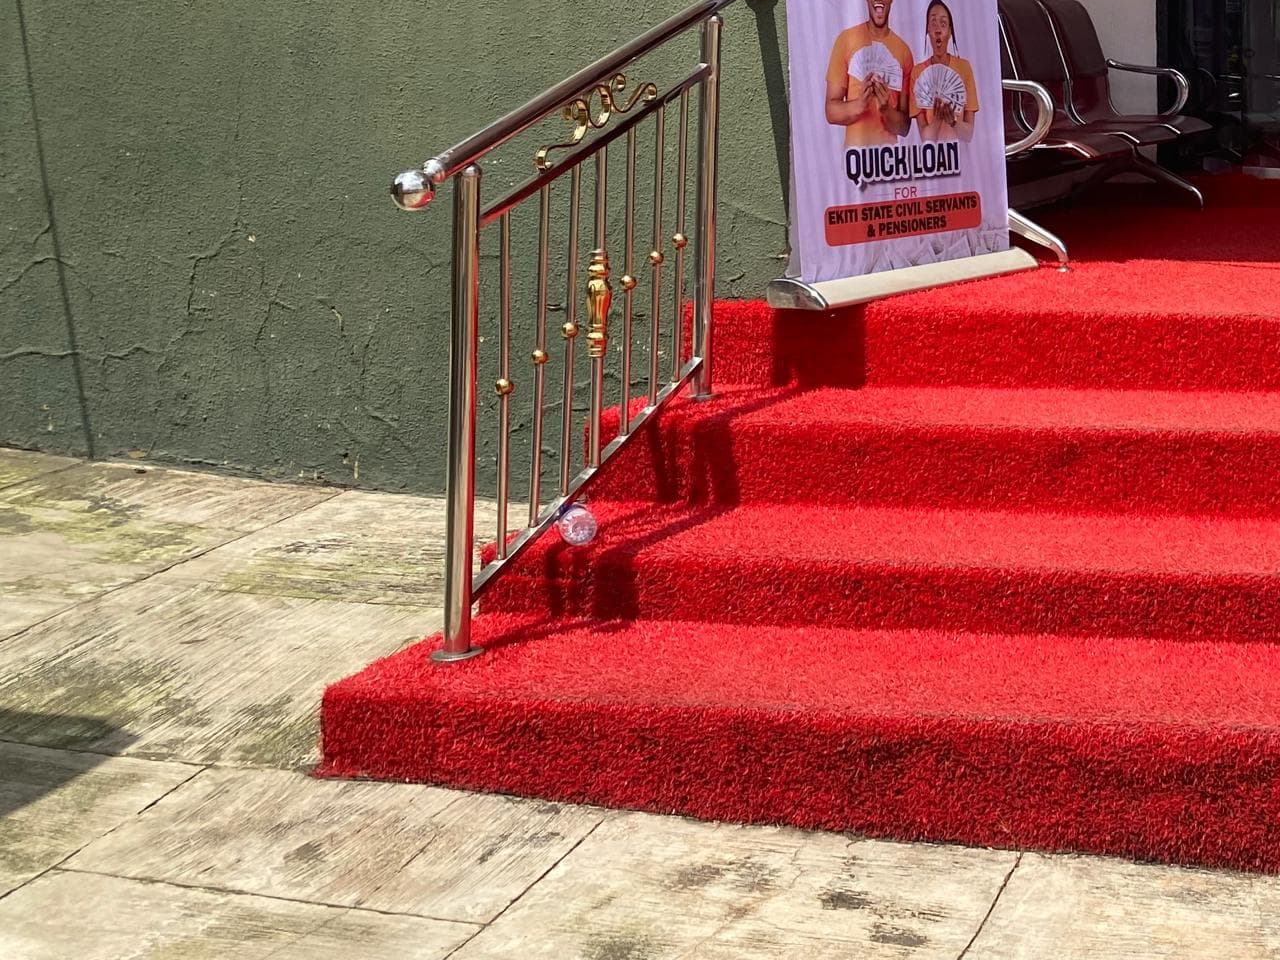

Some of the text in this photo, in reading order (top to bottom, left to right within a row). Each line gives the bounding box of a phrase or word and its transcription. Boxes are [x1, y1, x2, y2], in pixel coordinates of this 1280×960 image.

[845, 141, 961, 187] QUICK LOAN
[894, 186, 918, 199] FOR
[828, 195, 977, 226] EKITI STATE CIVIL SERVANTS
[867, 215, 947, 238] & PENSIONERS
